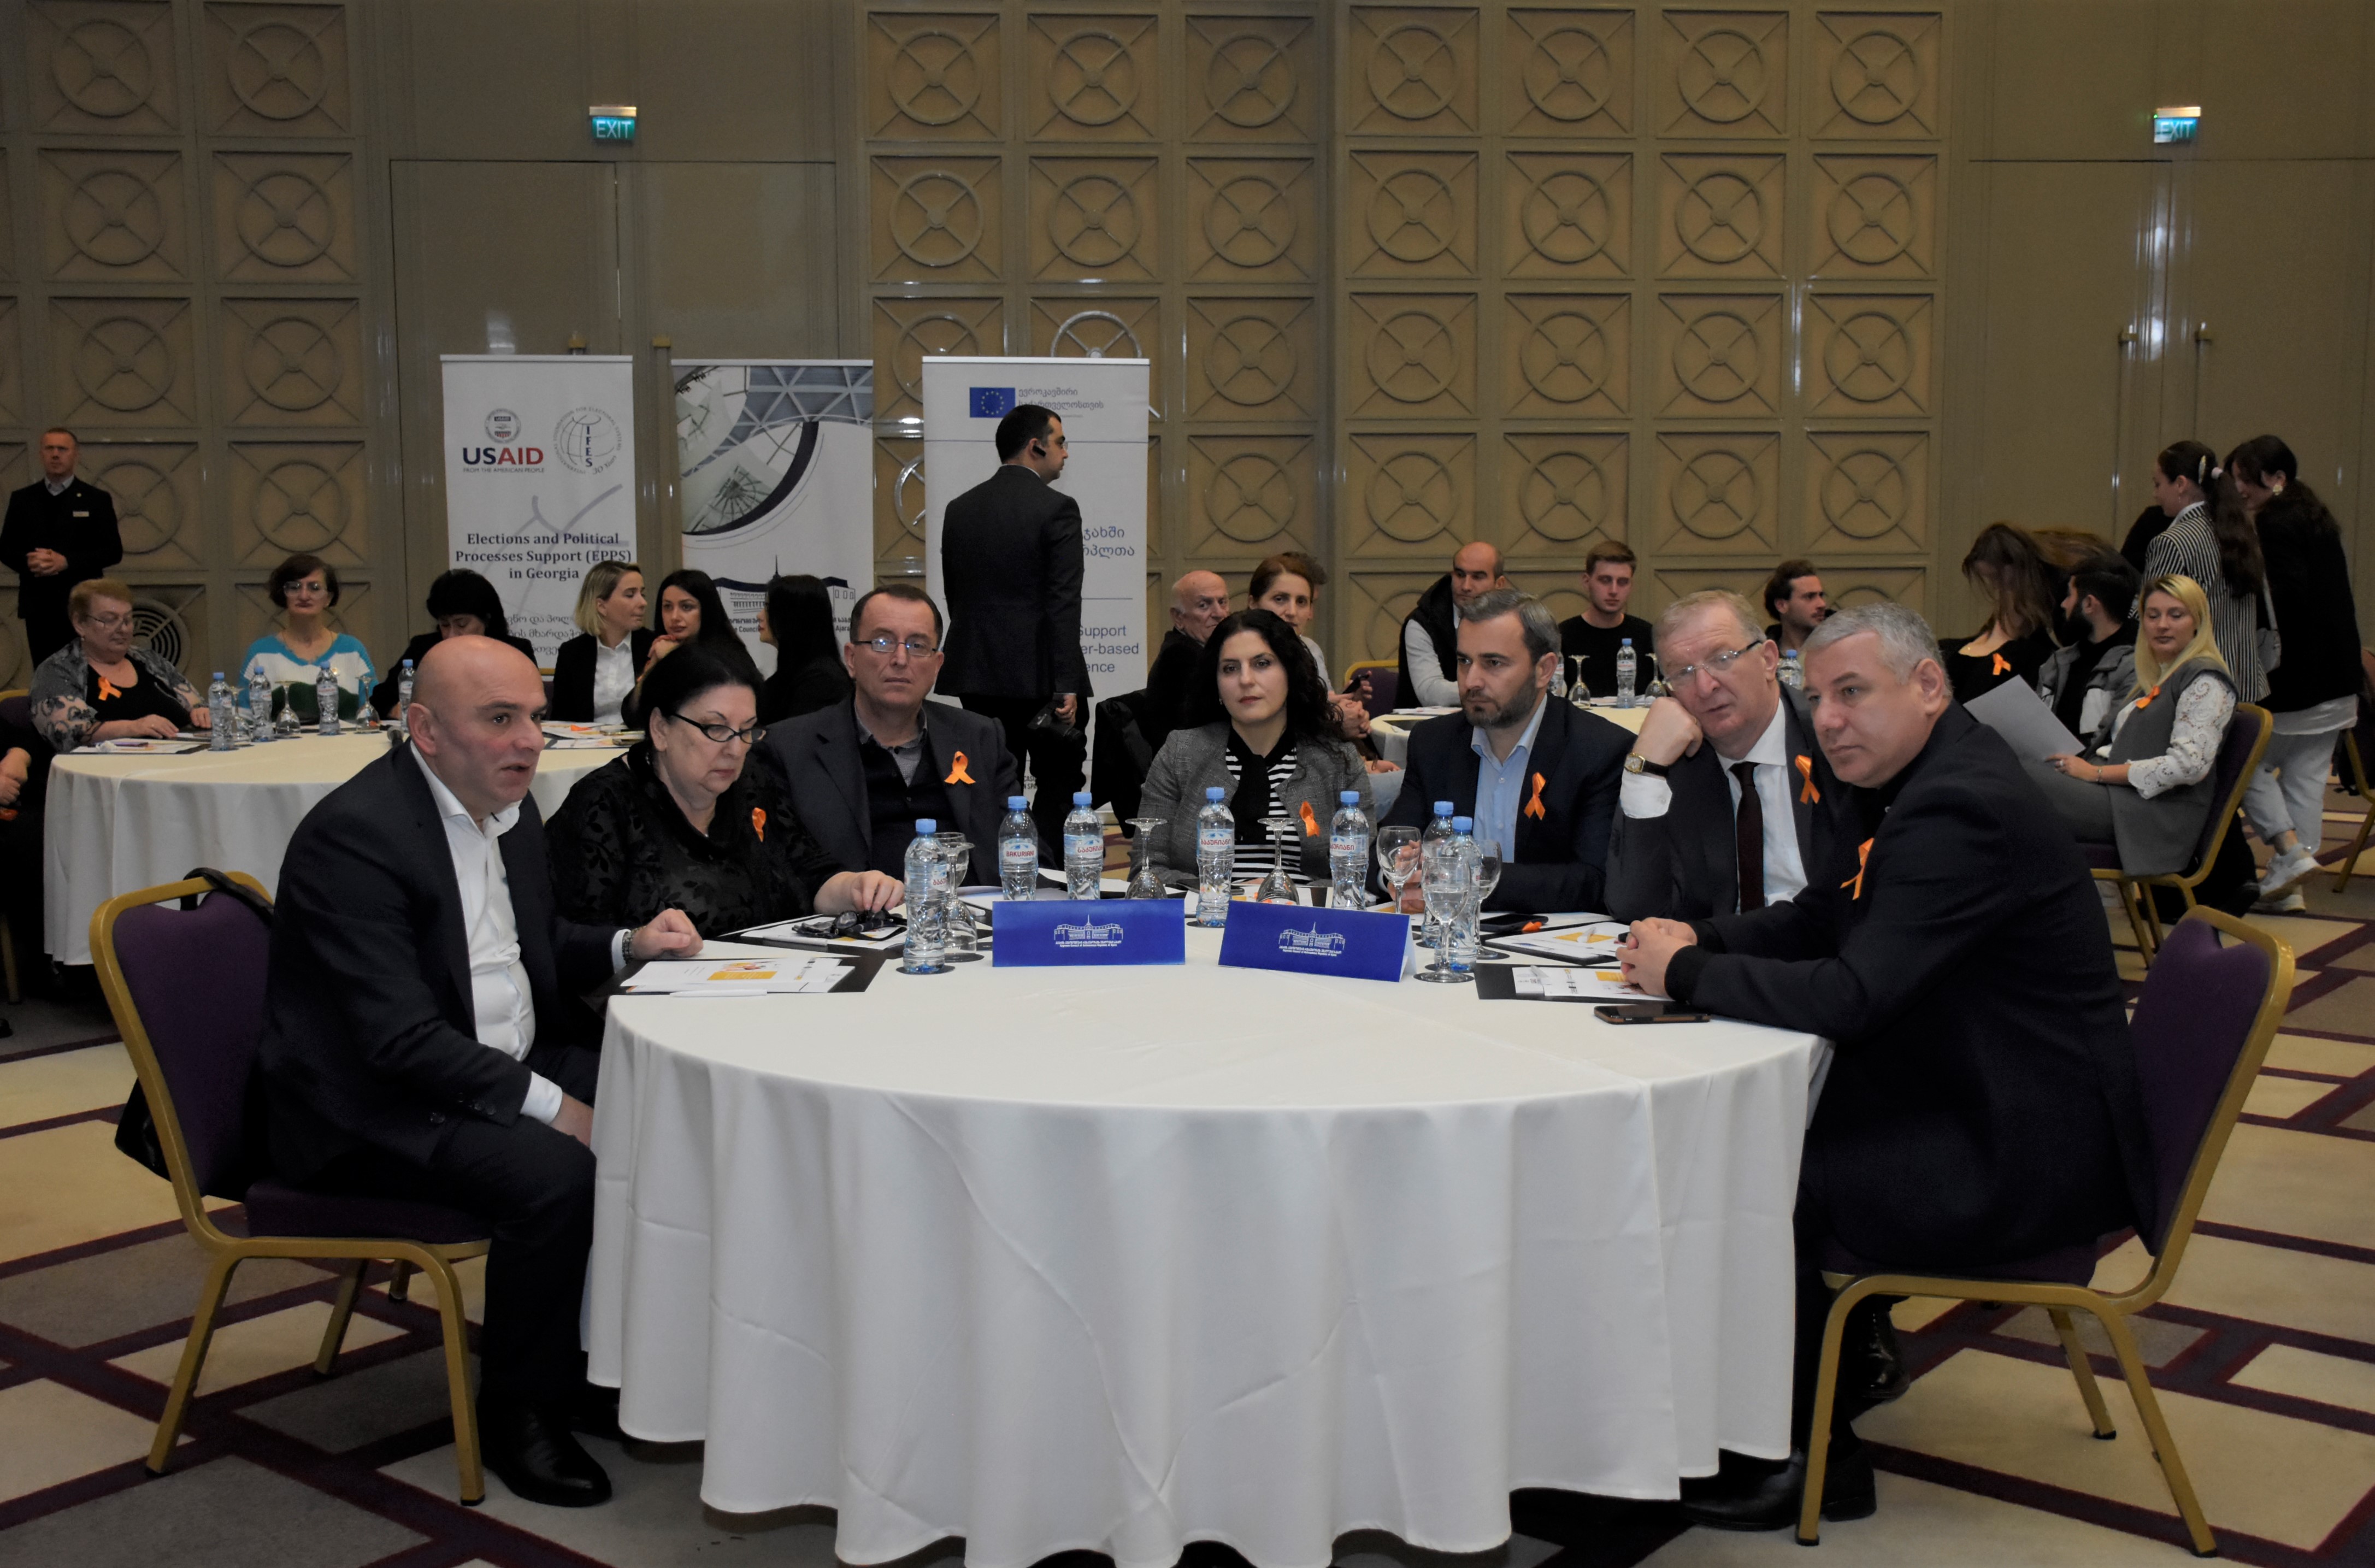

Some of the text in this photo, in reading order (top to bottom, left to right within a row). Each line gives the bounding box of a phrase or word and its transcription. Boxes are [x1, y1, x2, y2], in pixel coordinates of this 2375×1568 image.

[596, 120, 632, 138] EXIT
[2160, 121, 2194, 139] EXIT
[463, 447, 544, 465] USAID
[467, 533, 619, 545] Elections and Political
[1083, 526, 1125, 541] ჯახში
[456, 550, 632, 564] Processes Support (EPPS)
[509, 568, 579, 581] in Georgia
[1081, 642, 1139, 655] er-based
[1086, 663, 1115, 673] ence
